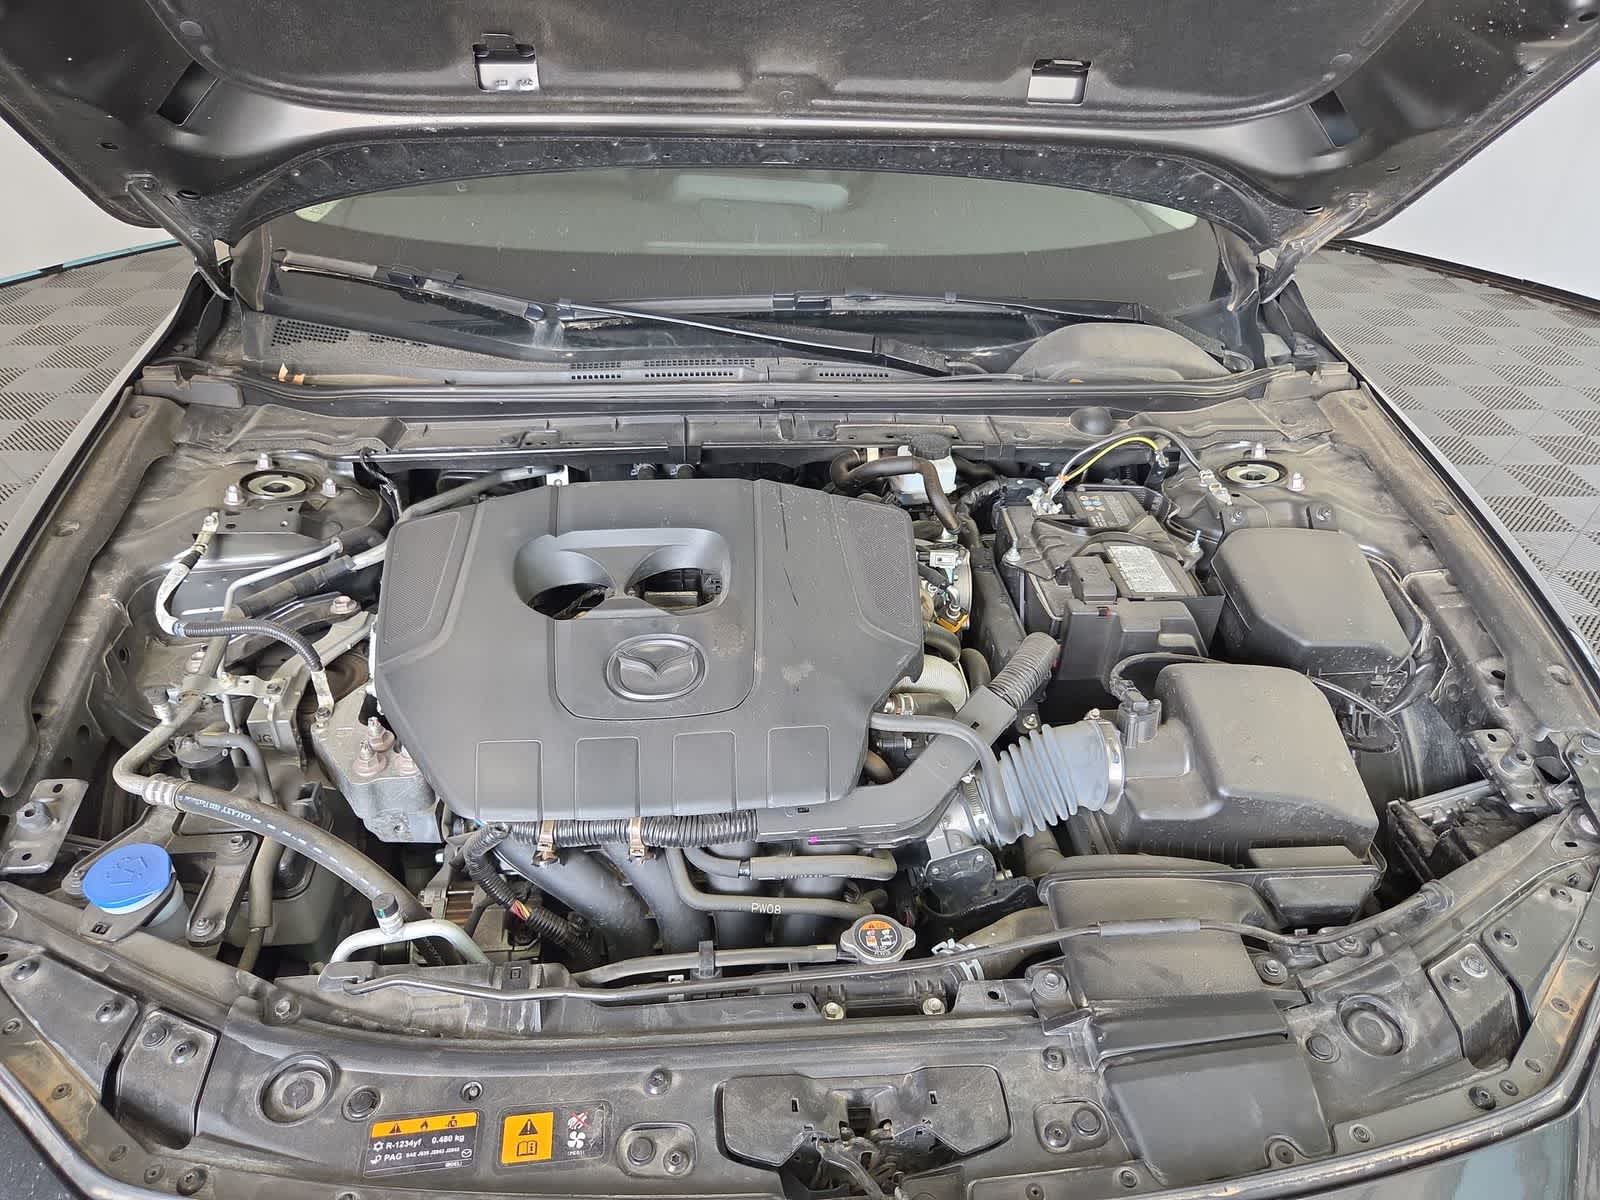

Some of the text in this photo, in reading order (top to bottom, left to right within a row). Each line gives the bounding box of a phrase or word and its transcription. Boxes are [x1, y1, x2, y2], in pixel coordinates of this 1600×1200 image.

[751, 902, 782, 914] PW08
[385, 1138, 422, 1150] R-1234yf
[454, 1134, 465, 1143] kg
[383, 1152, 403, 1162] PAG
